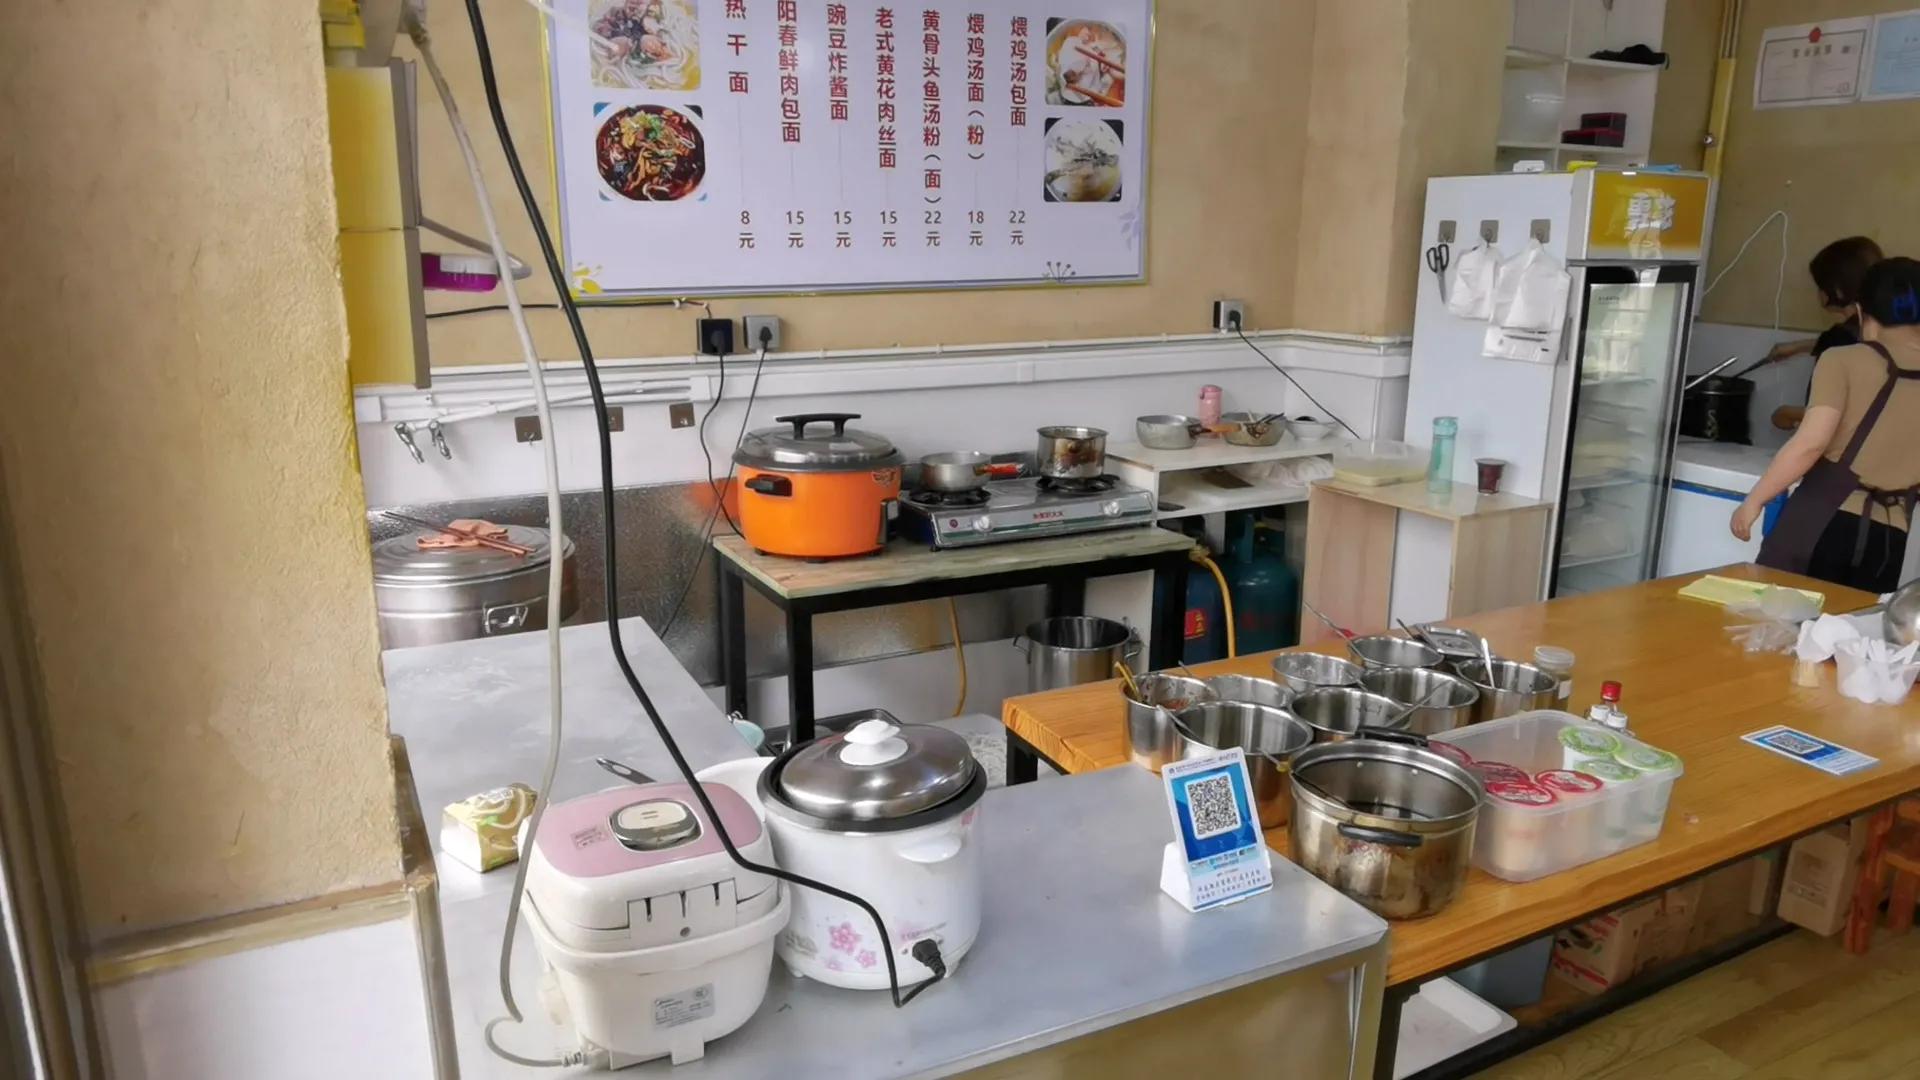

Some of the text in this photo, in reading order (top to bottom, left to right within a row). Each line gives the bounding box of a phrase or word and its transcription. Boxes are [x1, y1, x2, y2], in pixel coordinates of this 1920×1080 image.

[726, 0, 749, 94] 热干面
[777, 0, 801, 143] 阳春鲜肉包面
[826, 4, 849, 121] 豌豆炸酱面
[875, 6, 897, 168] 老式黄花肉丝面
[1010, 16, 1028, 127] 煨鸡汤包面
